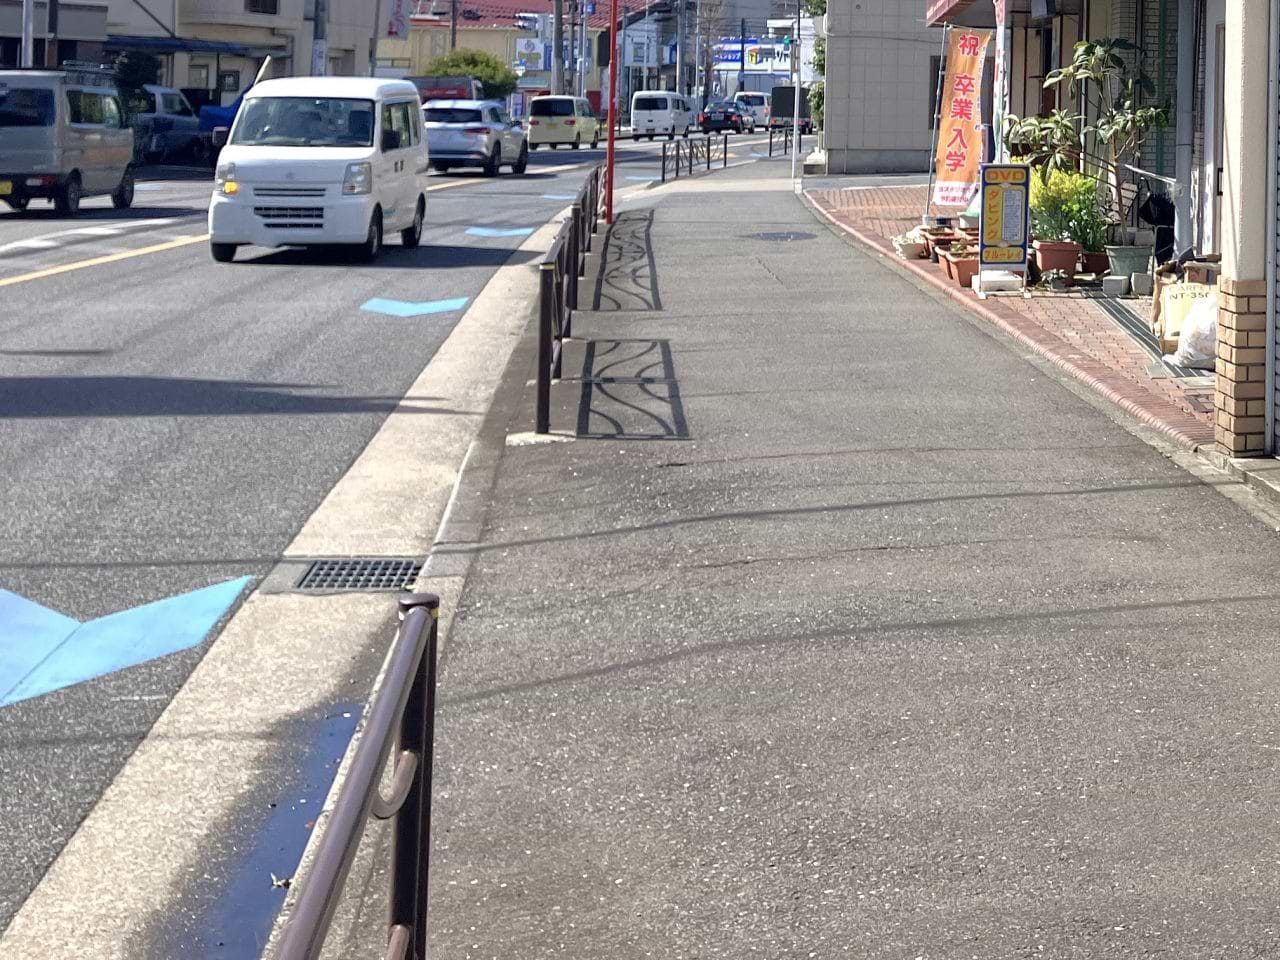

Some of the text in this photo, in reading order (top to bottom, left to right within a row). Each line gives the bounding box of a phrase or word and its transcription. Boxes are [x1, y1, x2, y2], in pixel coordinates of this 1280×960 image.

[945, 34, 980, 173] 祝 卒業 入学
[986, 170, 1024, 181] DVD
